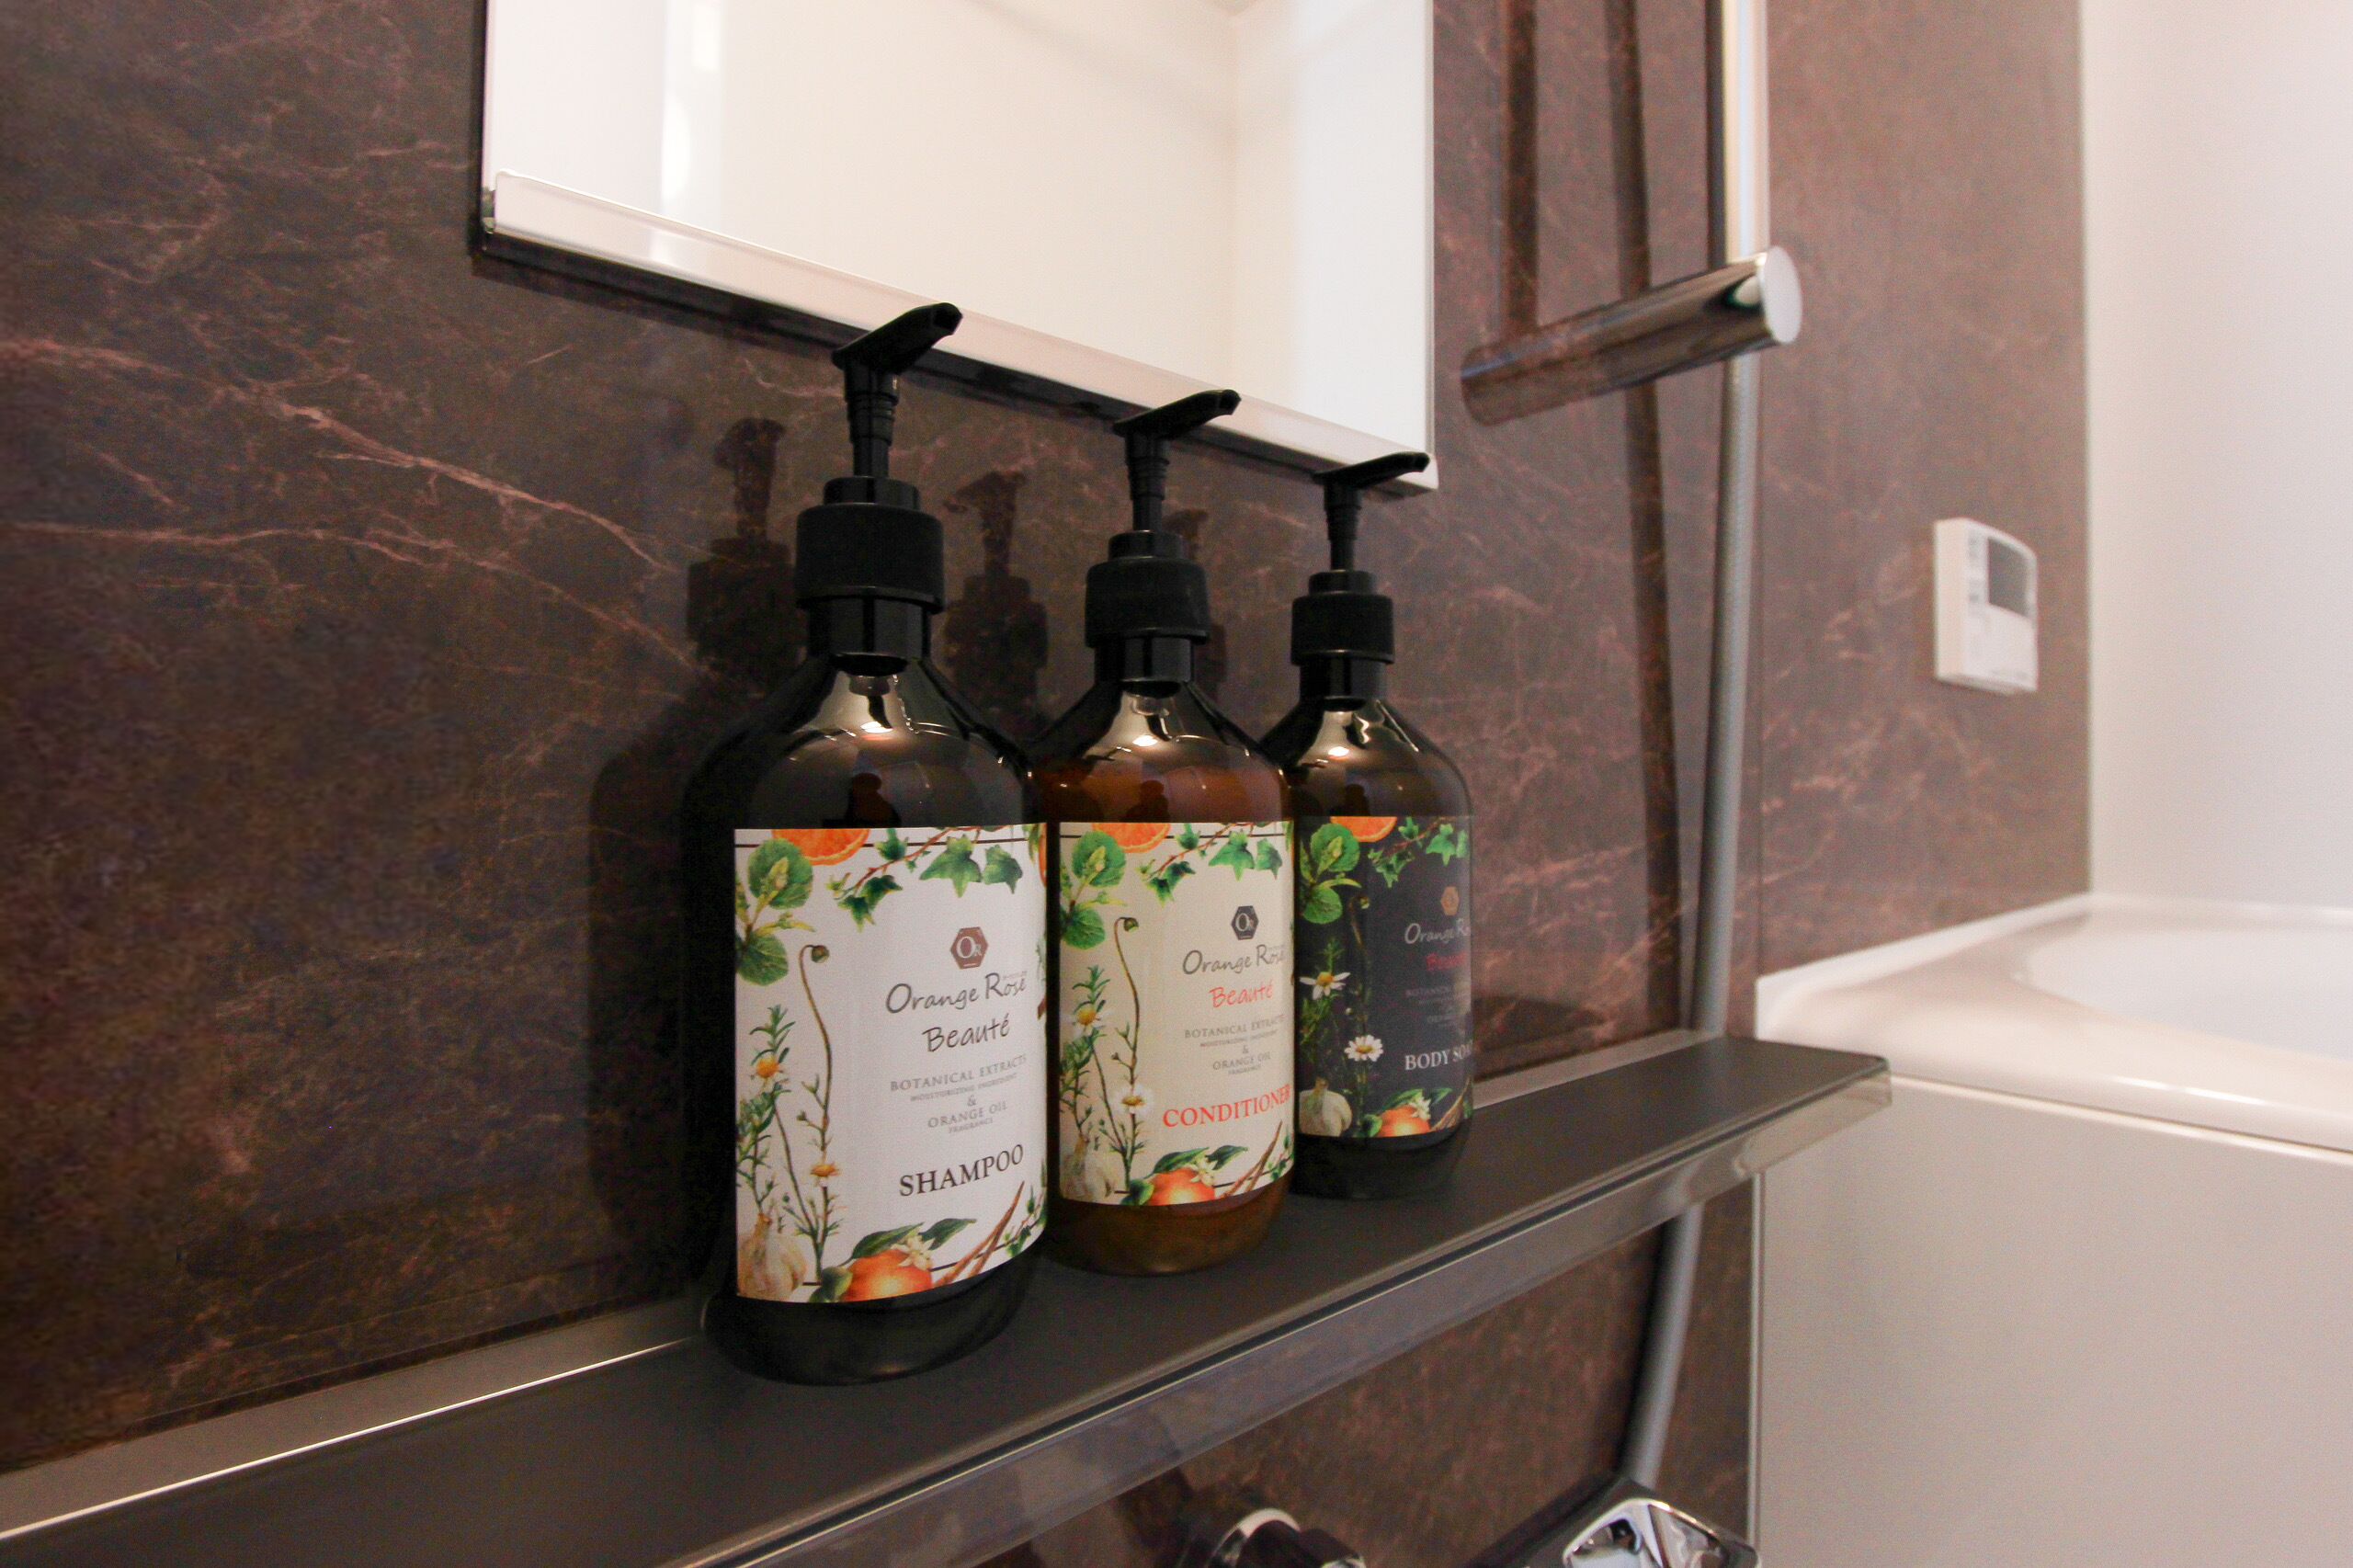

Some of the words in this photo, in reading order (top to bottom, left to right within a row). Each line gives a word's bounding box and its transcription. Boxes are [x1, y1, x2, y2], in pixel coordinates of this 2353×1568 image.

[1182, 949, 1251, 975] Orange
[886, 983, 979, 1013] Orange
[1209, 978, 1274, 1008] Beauté
[922, 1013, 1010, 1051] Beauté
[1184, 1023, 1247, 1039] BOTANICAL
[1404, 1048, 1450, 1071] BODY
[890, 1070, 974, 1092] BOTANICAL
[967, 1094, 976, 1107] &
[927, 1107, 983, 1129] ORANGE
[988, 1100, 1007, 1115] OIL
[898, 1143, 1024, 1197] SHAMPOO
